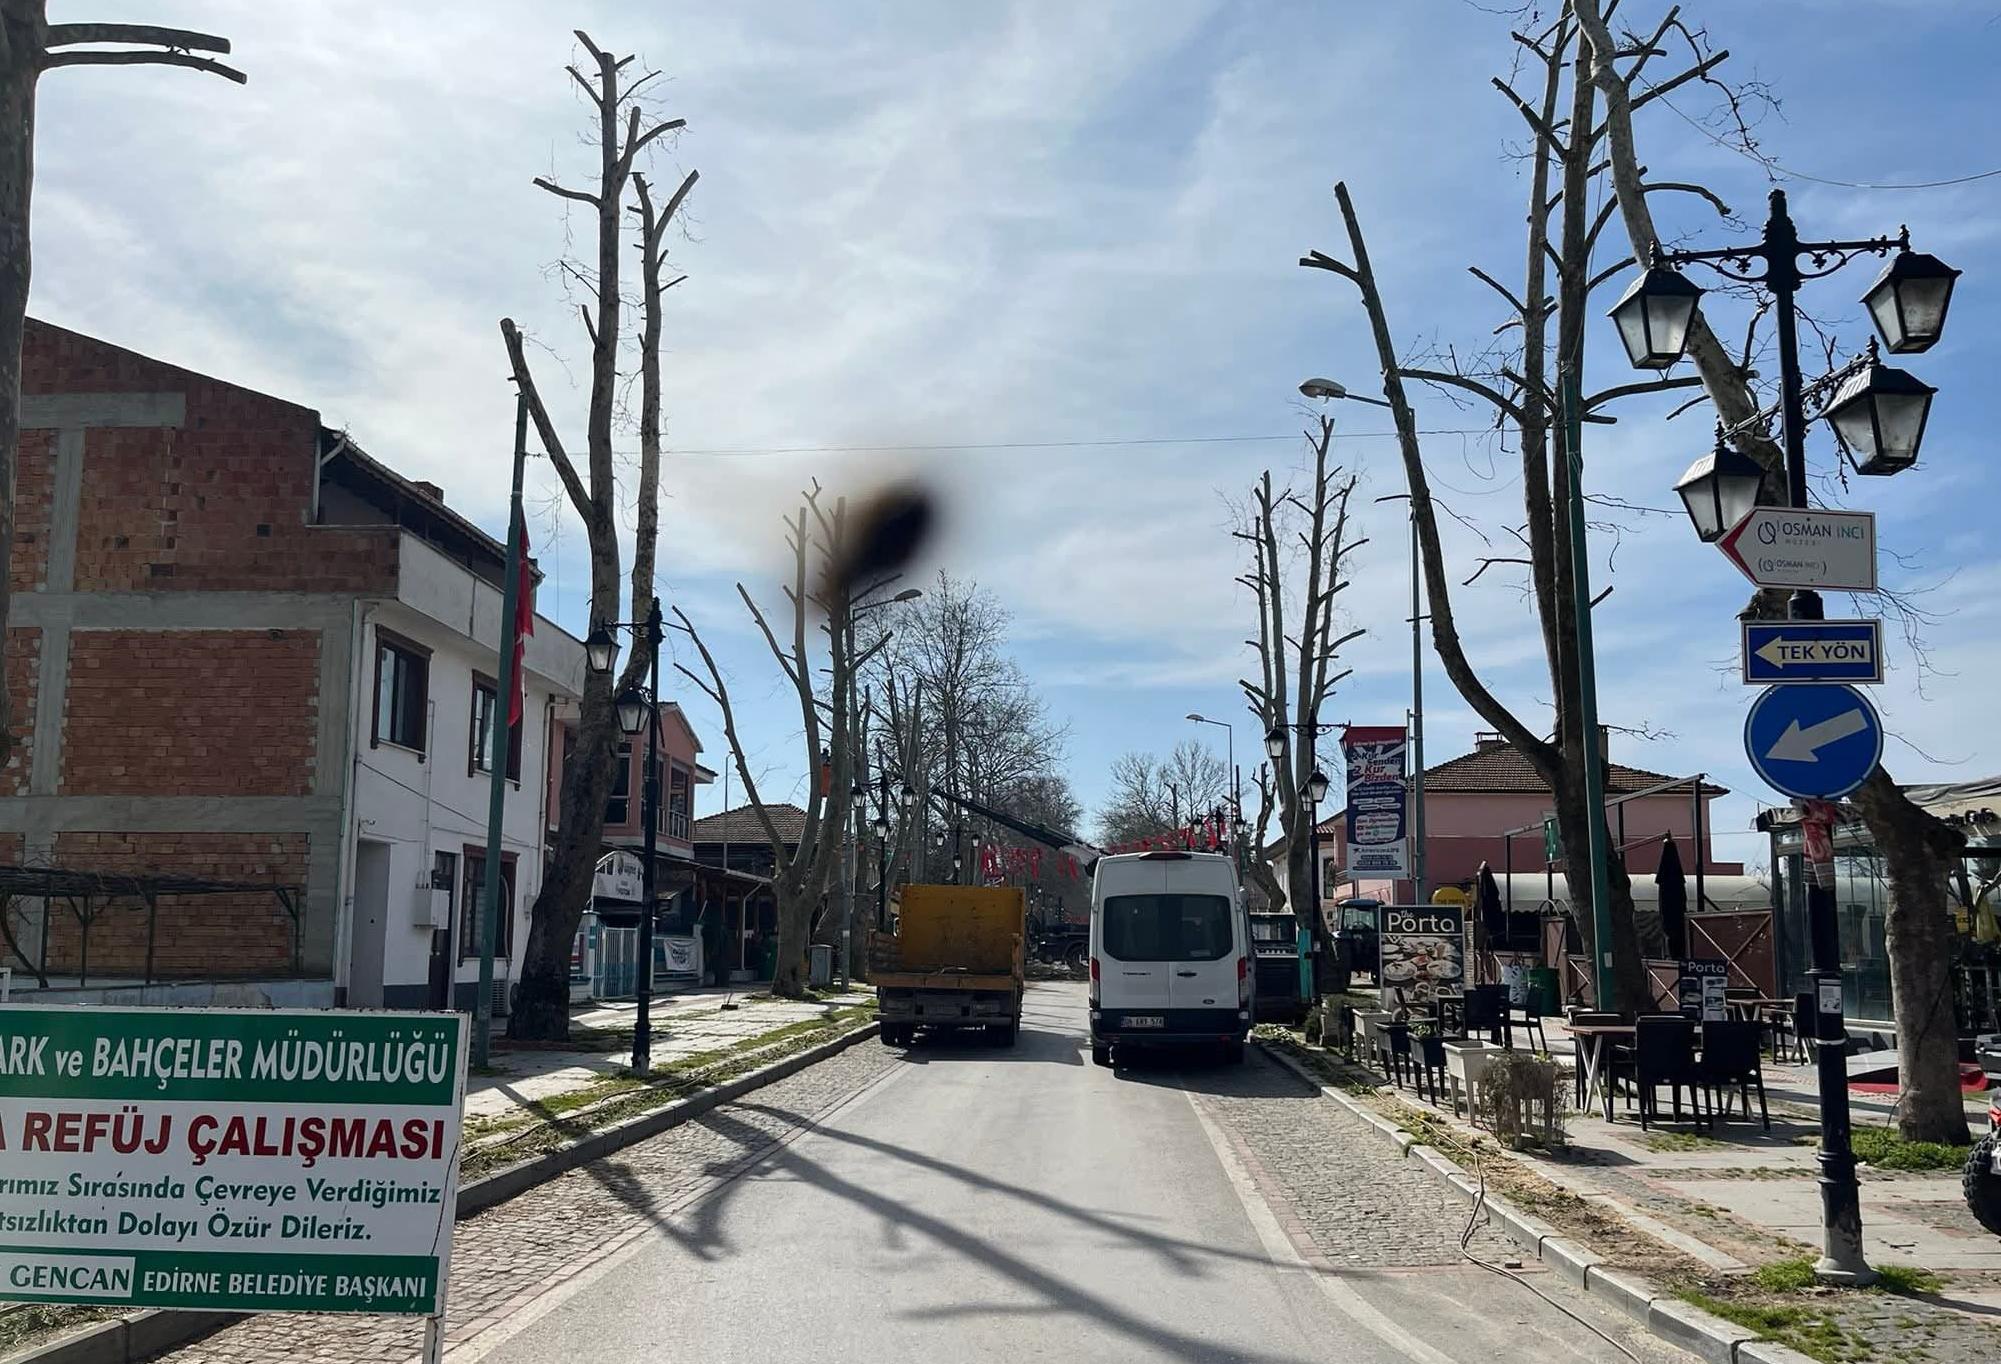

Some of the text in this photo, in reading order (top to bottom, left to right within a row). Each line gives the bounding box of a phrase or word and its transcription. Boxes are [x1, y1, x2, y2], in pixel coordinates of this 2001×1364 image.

[1782, 522, 1831, 537] OSMAN
[1777, 640, 1865, 660] TEK YÖN
[1388, 912, 1455, 932] Porta
[1688, 961, 1725, 973] Porta
[56, 1050, 82, 1076] ve
[92, 1036, 242, 1089] BAHÇELER
[251, 1030, 449, 1084] MÜDÜRLÜĞÜ
[22, 1106, 172, 1153] REFÜJ
[188, 1116, 445, 1167] ÇALIŞMASI
[68, 1173, 185, 1199] Sırasında
[194, 1176, 296, 1205] Çevreye
[306, 1179, 440, 1208] Verdiğimiz
[118, 1212, 198, 1242] Dolayı
[207, 1208, 271, 1239] Özür
[281, 1217, 372, 1240] Dileriz.
[10, 1265, 426, 1303] GENCAN EDİRNE BELEDİYE BAŞKANI
